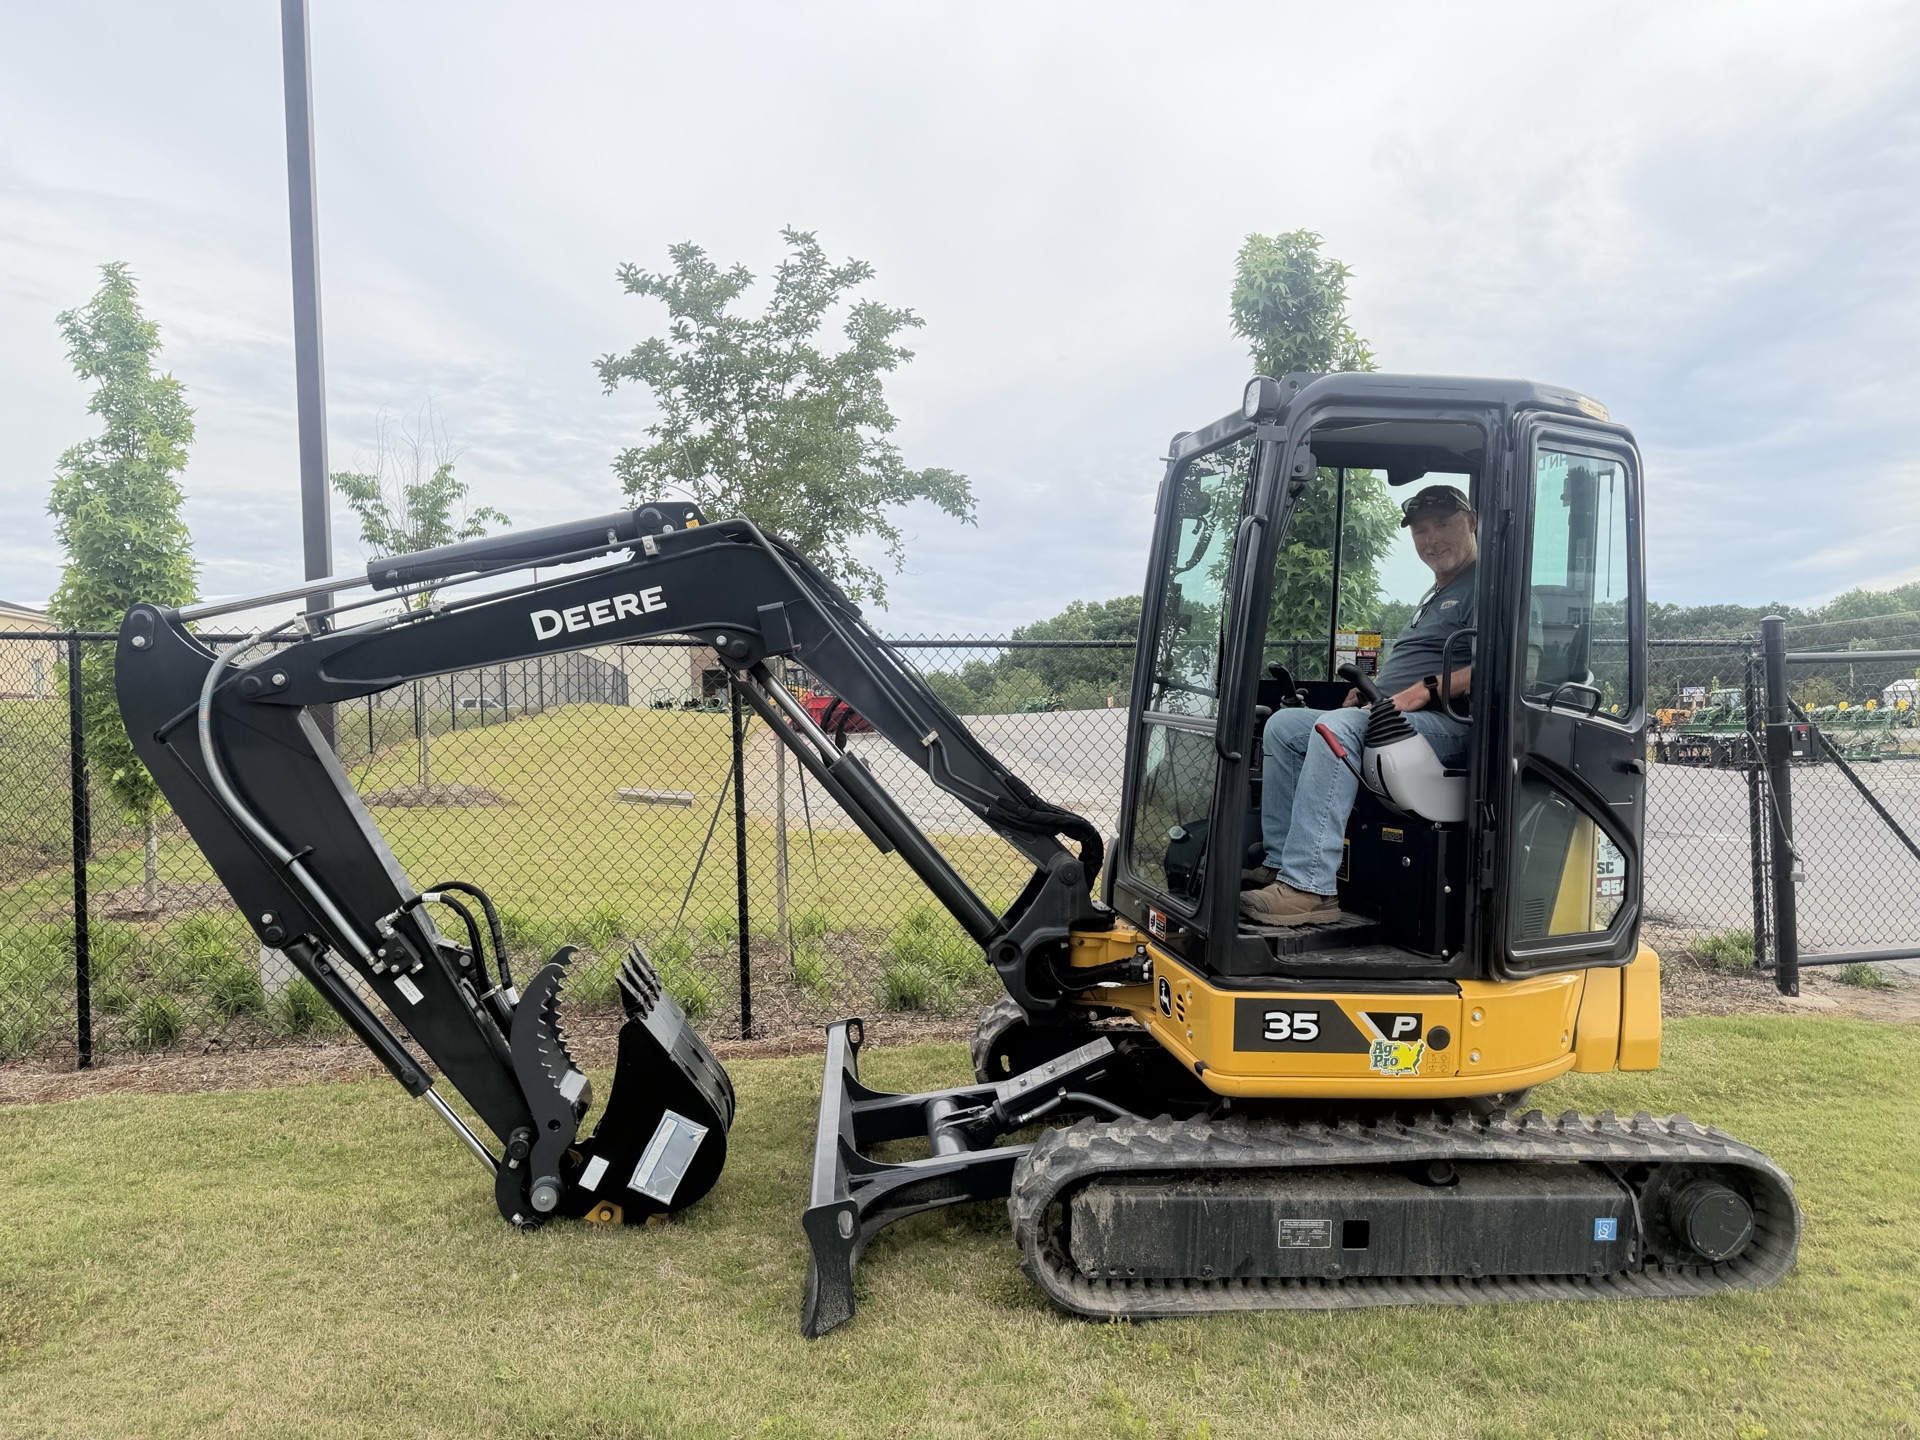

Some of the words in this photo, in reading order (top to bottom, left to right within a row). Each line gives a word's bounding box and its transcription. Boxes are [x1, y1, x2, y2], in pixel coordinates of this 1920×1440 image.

[530, 586, 667, 640] DEERE
[1264, 1011, 1319, 1041] 35
[1391, 1015, 1418, 1038] P
[1373, 1055, 1399, 1067] Pro
